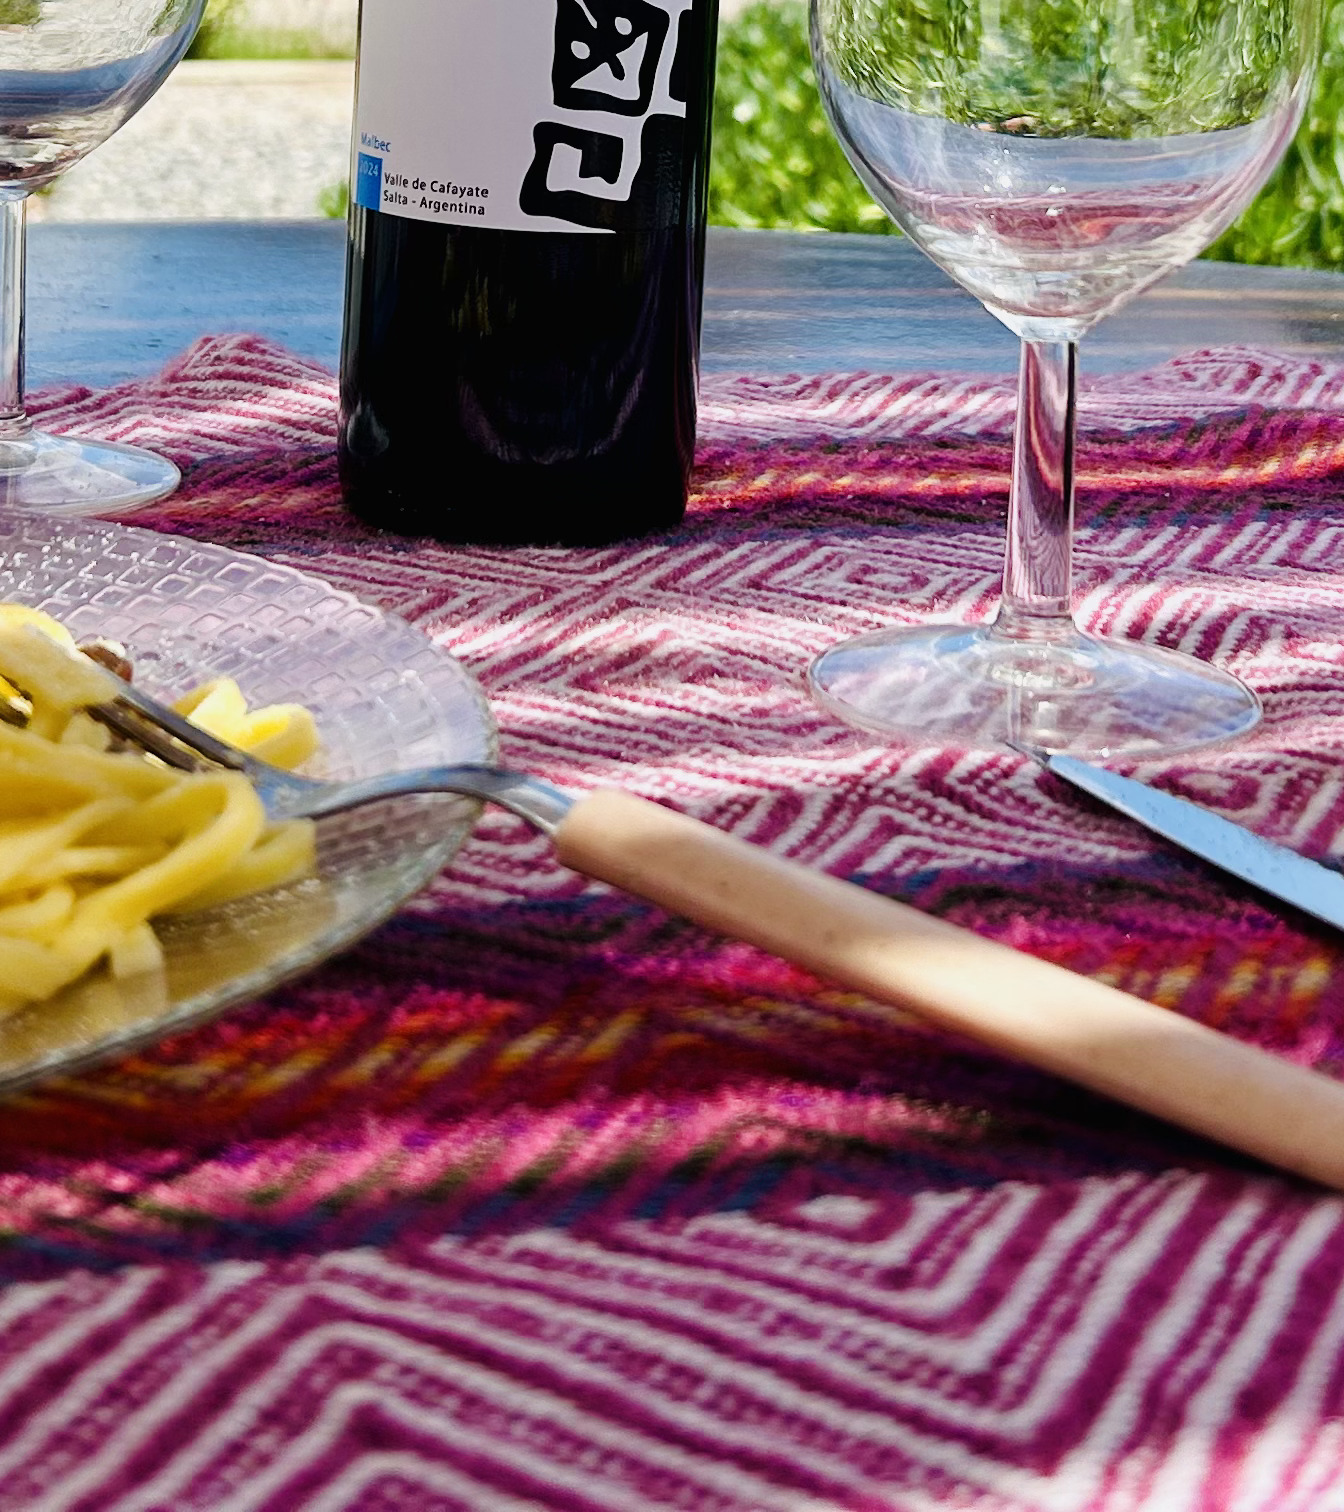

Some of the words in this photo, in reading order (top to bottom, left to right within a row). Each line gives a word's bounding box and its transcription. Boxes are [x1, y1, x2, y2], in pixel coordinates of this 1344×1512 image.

[360, 131, 392, 153] Malbec
[384, 171, 409, 189] Valle
[412, 177, 427, 191] de
[430, 180, 489, 199] Cafayate
[383, 189, 408, 206] Salta
[419, 196, 485, 216] Argentina
